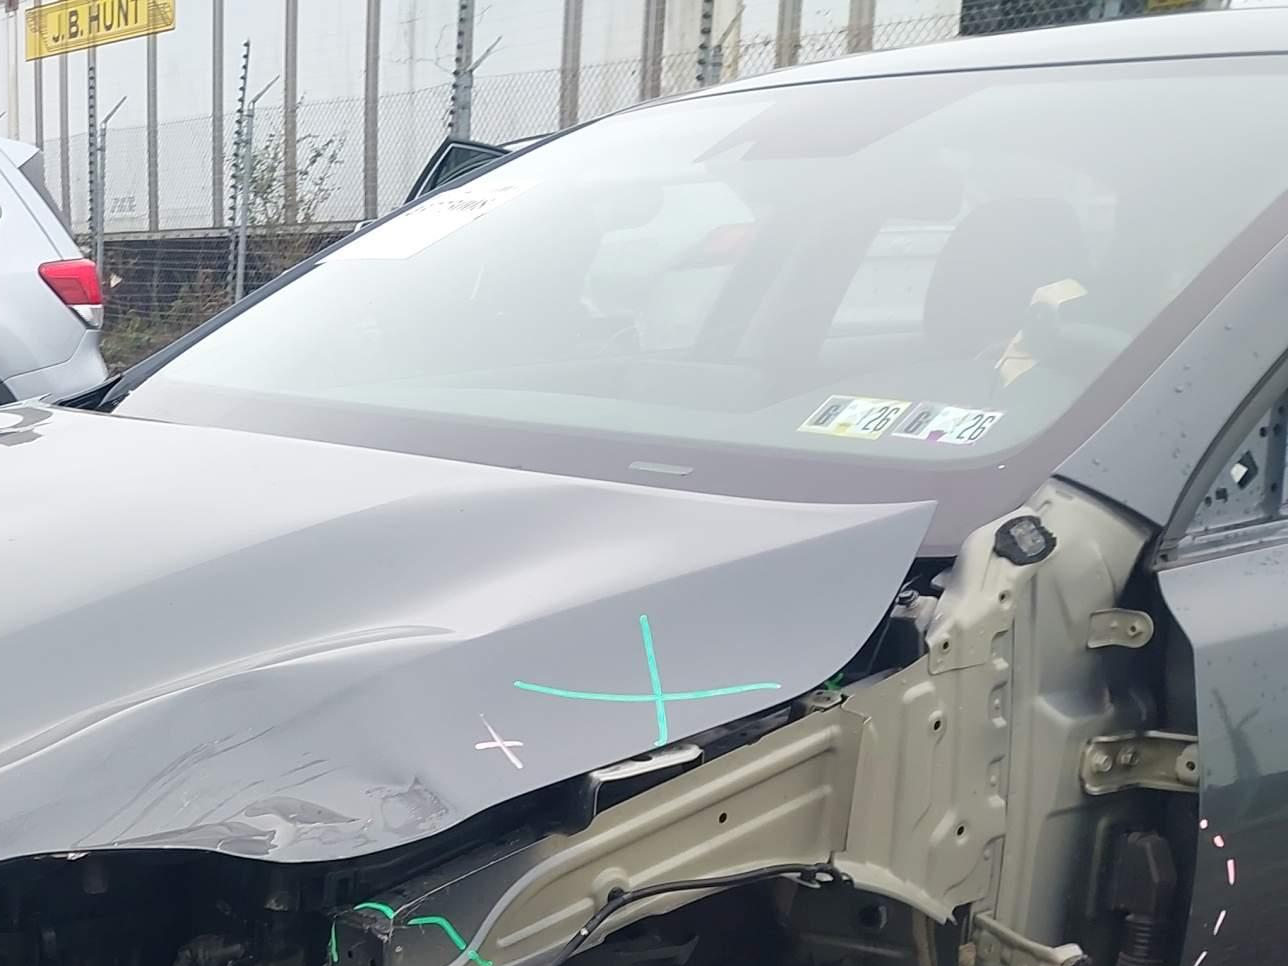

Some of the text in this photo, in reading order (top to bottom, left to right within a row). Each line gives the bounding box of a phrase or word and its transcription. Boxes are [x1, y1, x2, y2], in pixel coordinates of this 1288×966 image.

[88, 0, 138, 35] HUNT
[861, 405, 901, 432] 26
[956, 413, 996, 441] 26
